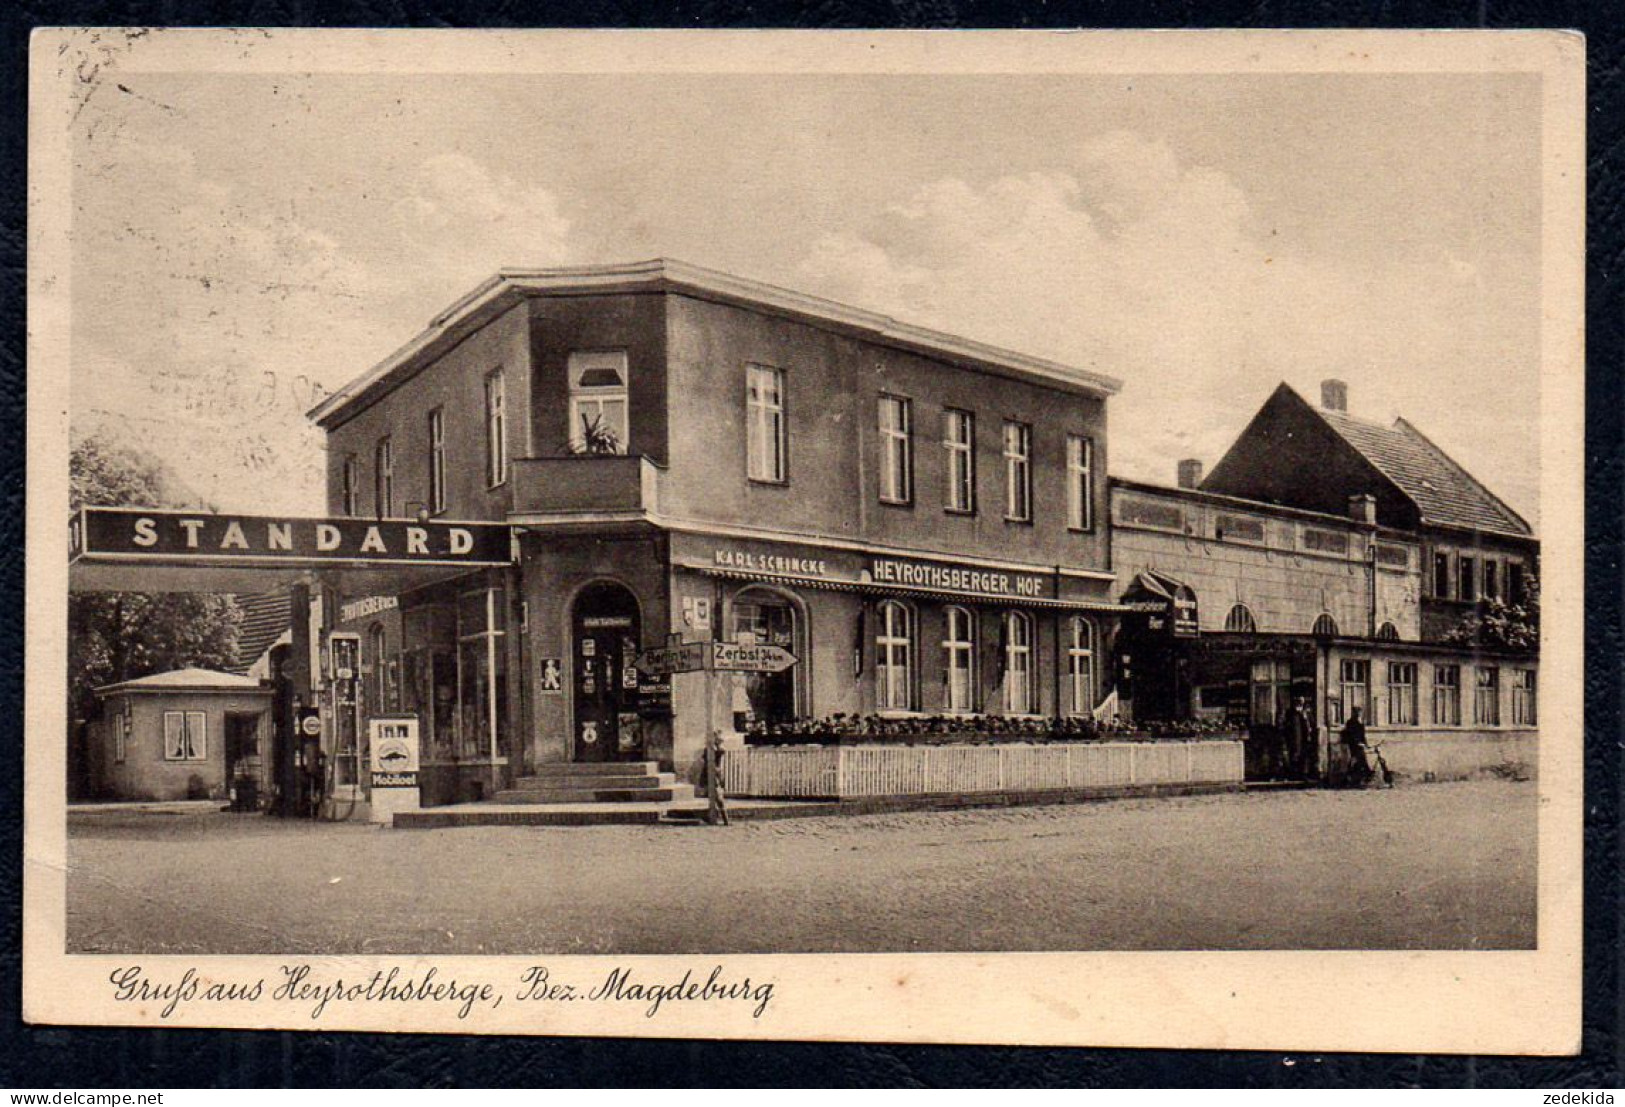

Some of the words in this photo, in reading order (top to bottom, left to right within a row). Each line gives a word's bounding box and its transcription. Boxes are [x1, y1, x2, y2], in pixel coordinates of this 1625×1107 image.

[132, 518, 474, 555] STANDARD
[716, 551, 755, 567] KARL
[759, 555, 826, 573] SCHINCKE
[874, 560, 1009, 592] HEYROTHSBERGER
[1017, 577, 1043, 595] HOF
[715, 645, 760, 660] Zerbst
[205, 979, 264, 1001] aus
[516, 966, 585, 1001] Bez.
[590, 965, 774, 1018] Magdeburg
